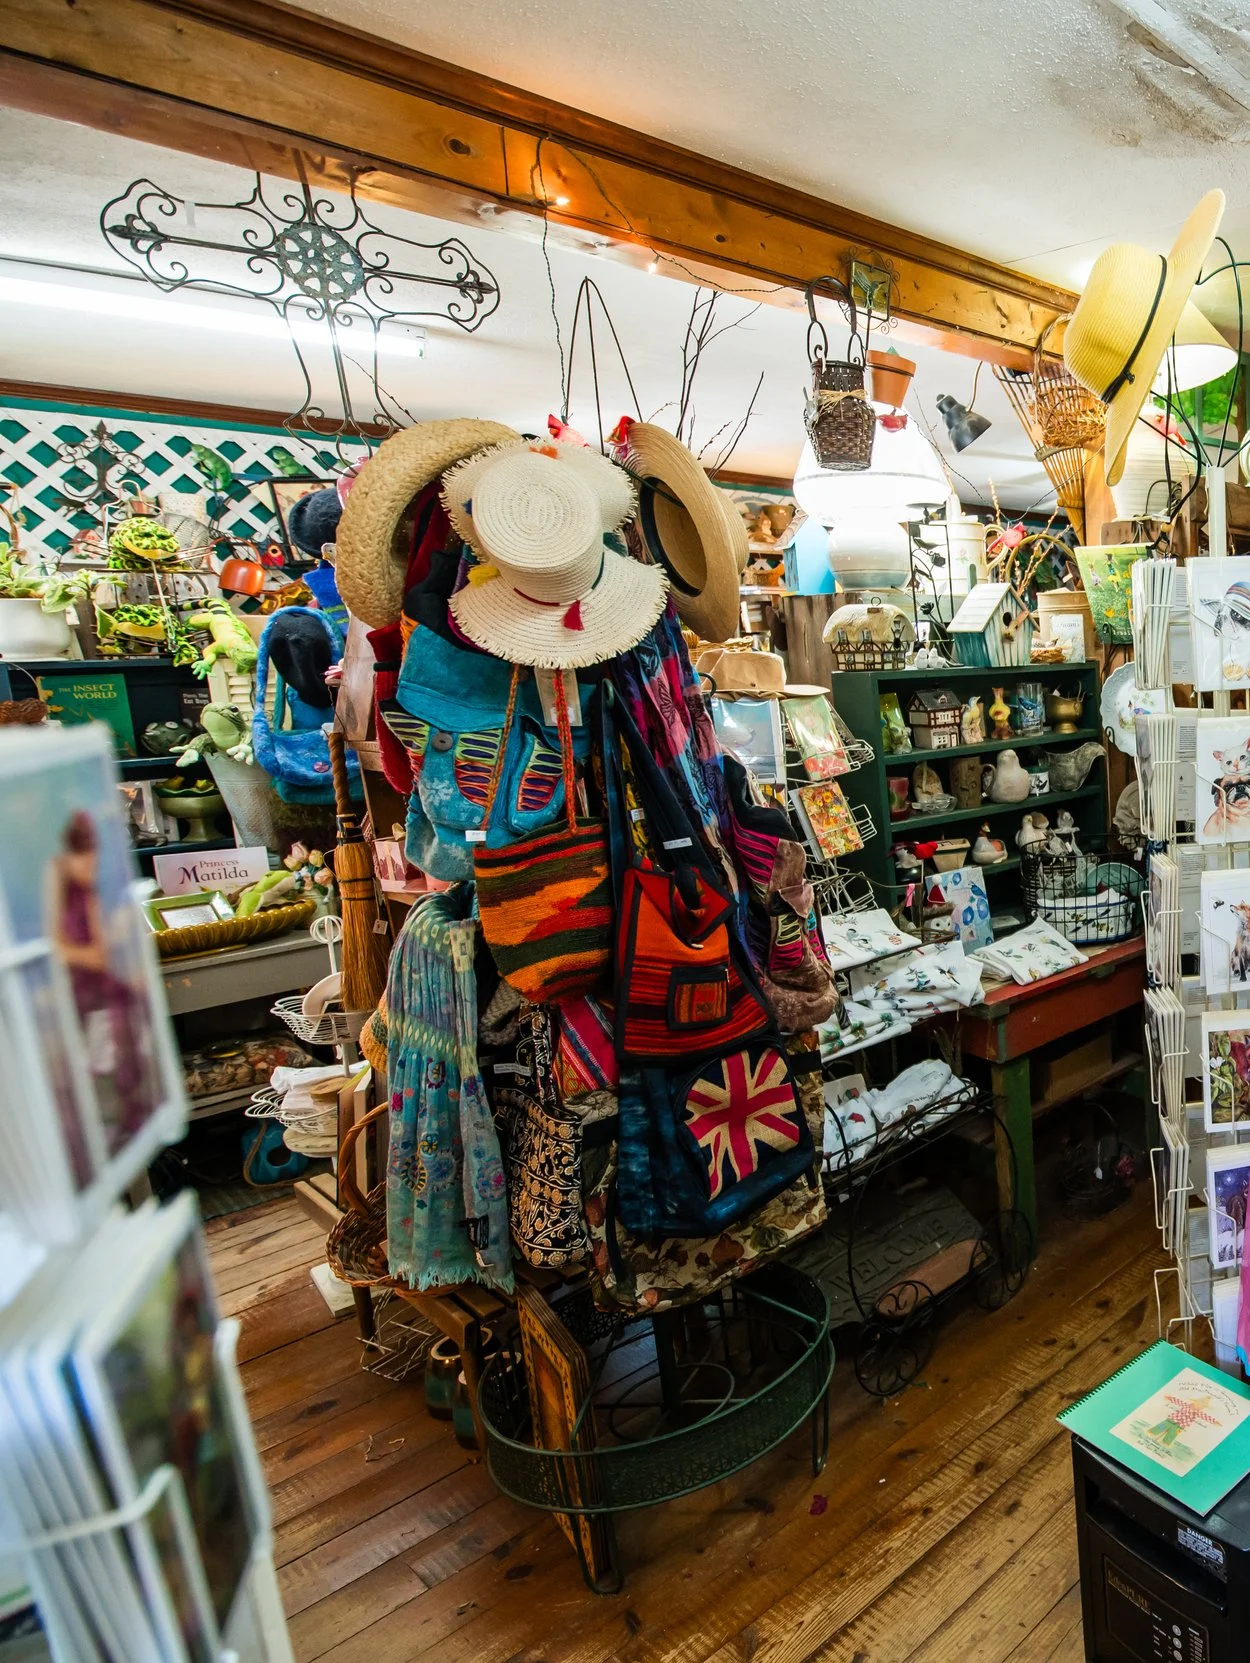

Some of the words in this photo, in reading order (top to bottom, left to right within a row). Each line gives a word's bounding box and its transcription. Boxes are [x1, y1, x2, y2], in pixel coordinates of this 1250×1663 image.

[73, 683, 115, 692] INSECT
[73, 691, 117, 700] WORLD
[199, 859, 239, 869] Princess
[178, 864, 248, 885] Matilda
[1186, 1527, 1213, 1547] DANGER
